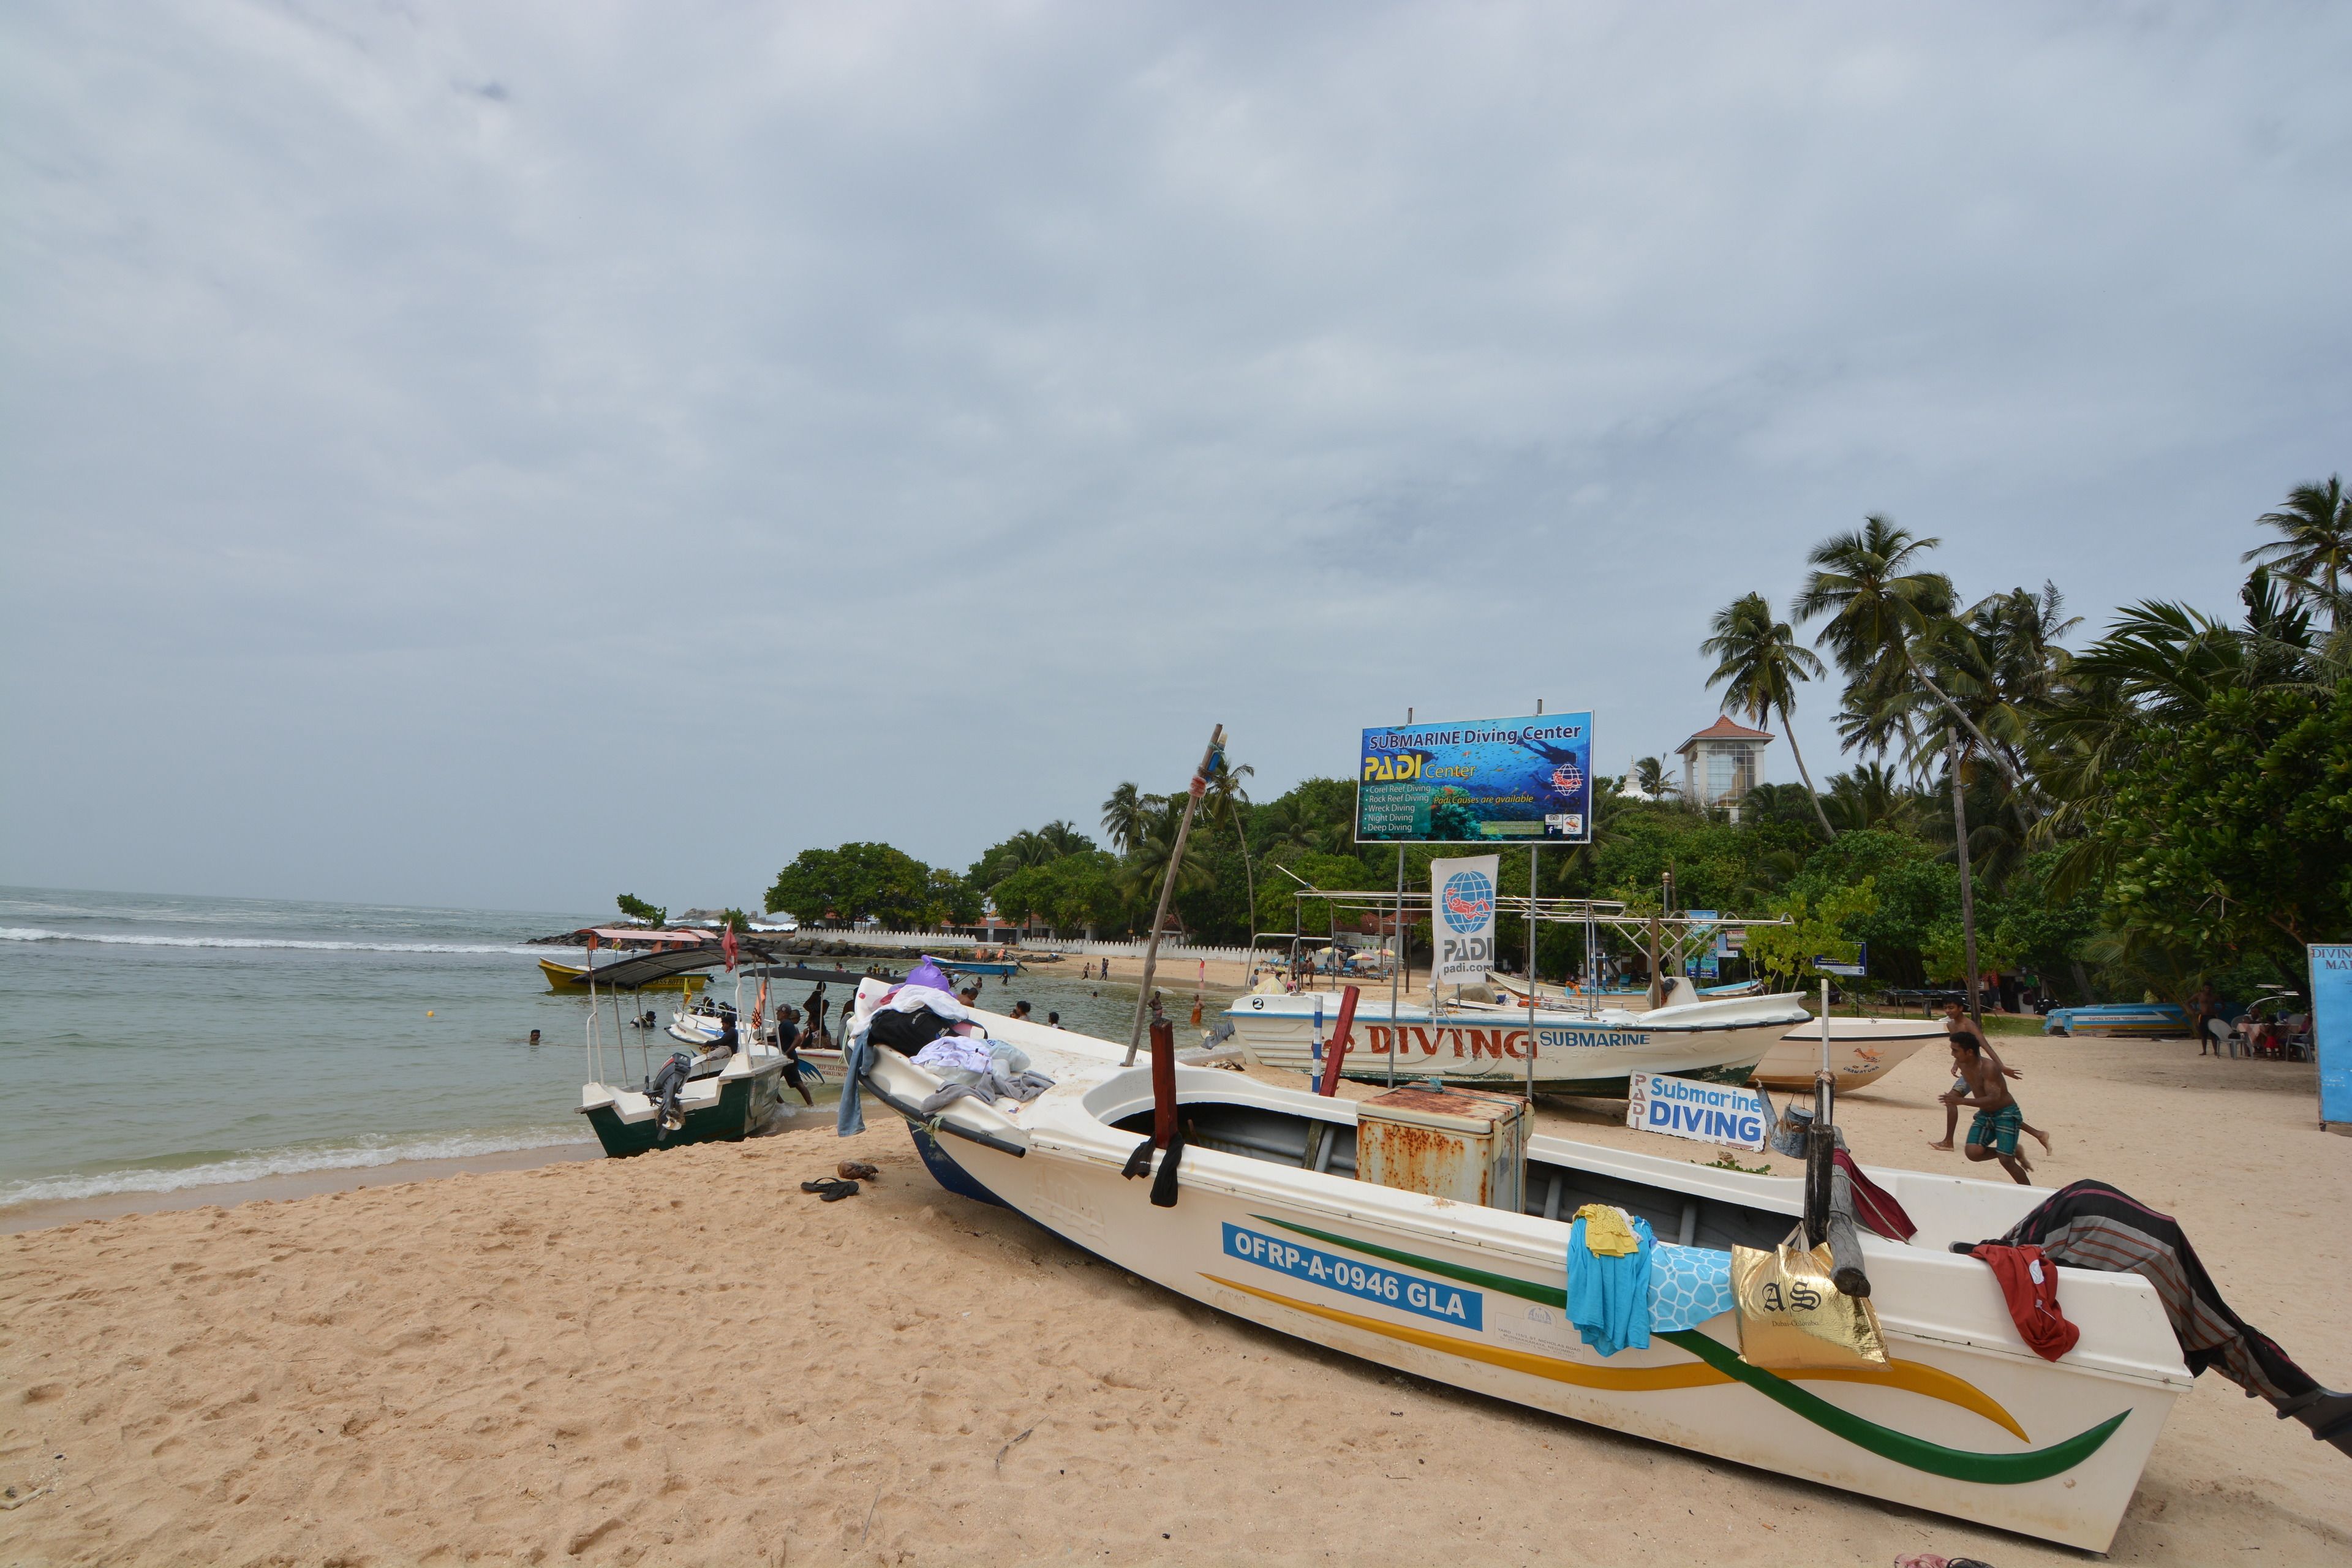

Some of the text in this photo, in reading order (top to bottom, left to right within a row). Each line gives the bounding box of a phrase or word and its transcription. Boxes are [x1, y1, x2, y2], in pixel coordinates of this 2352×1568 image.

[1370, 725, 1581, 749] SUBMARINE Diving Center
[1364, 754, 1477, 781] PADI Center
[1407, 784, 1431, 793] Diving
[1405, 794, 1429, 803] Diving
[1495, 794, 1534, 803] available
[1392, 804, 1415, 813] Diving
[1368, 814, 1413, 823] Night Diving
[1368, 823, 1412, 832] Deep Diving
[1444, 937, 1493, 962] PADI
[2312, 948, 2352, 959] DIVIN
[1444, 963, 1494, 975] padi.com
[1254, 998, 1262, 1008] 2
[1365, 1025, 1538, 1060] DIVING
[1540, 1031, 1651, 1047] SUBMARINE
[1651, 1077, 1762, 1113] Submarine
[1632, 1074, 1647, 1129] PADI
[1649, 1100, 1761, 1142] DIVING
[1235, 1232, 1466, 1320] OFRP-A-0946 GLA
[1538, 1338, 1565, 1348] NICHOLAS
